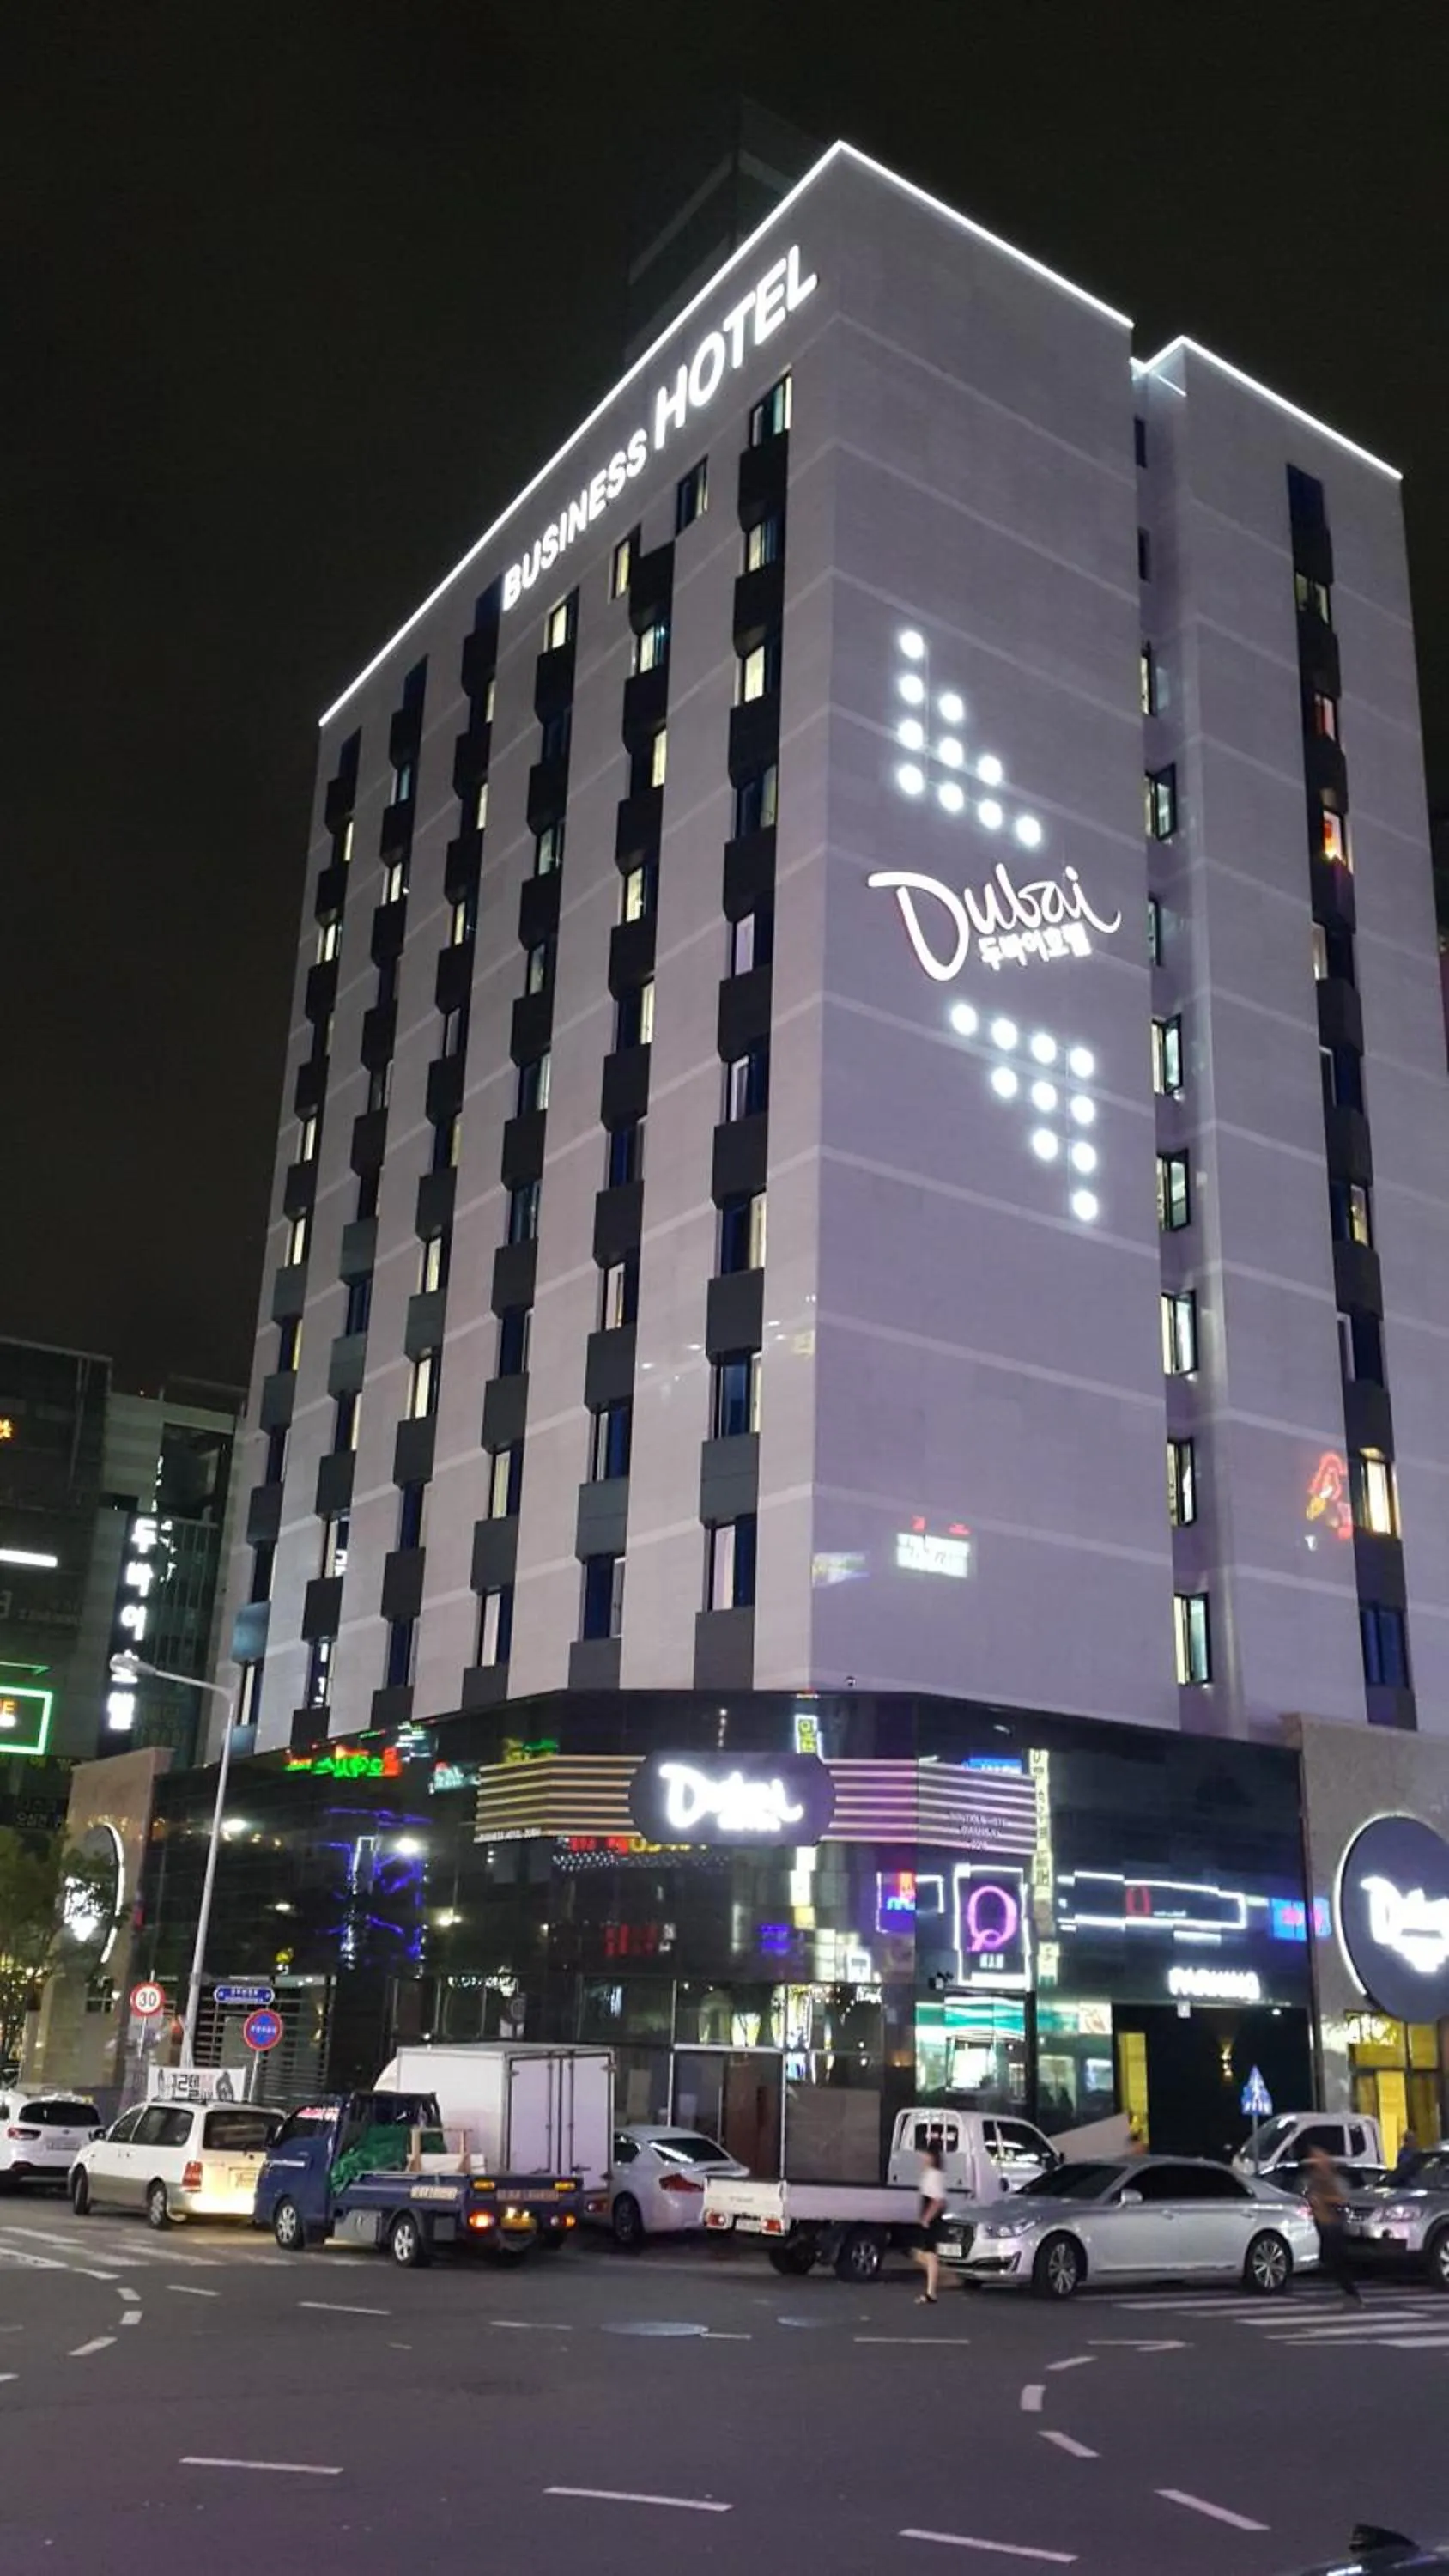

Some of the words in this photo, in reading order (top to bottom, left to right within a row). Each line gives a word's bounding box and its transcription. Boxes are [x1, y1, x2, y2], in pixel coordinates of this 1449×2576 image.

[502, 428, 647, 611] BUSINESS
[655, 244, 818, 451] HOTEL
[867, 862, 1122, 981] Dubai
[978, 922, 1093, 971] 두바이호텔
[138, 1991, 157, 2008] 30
